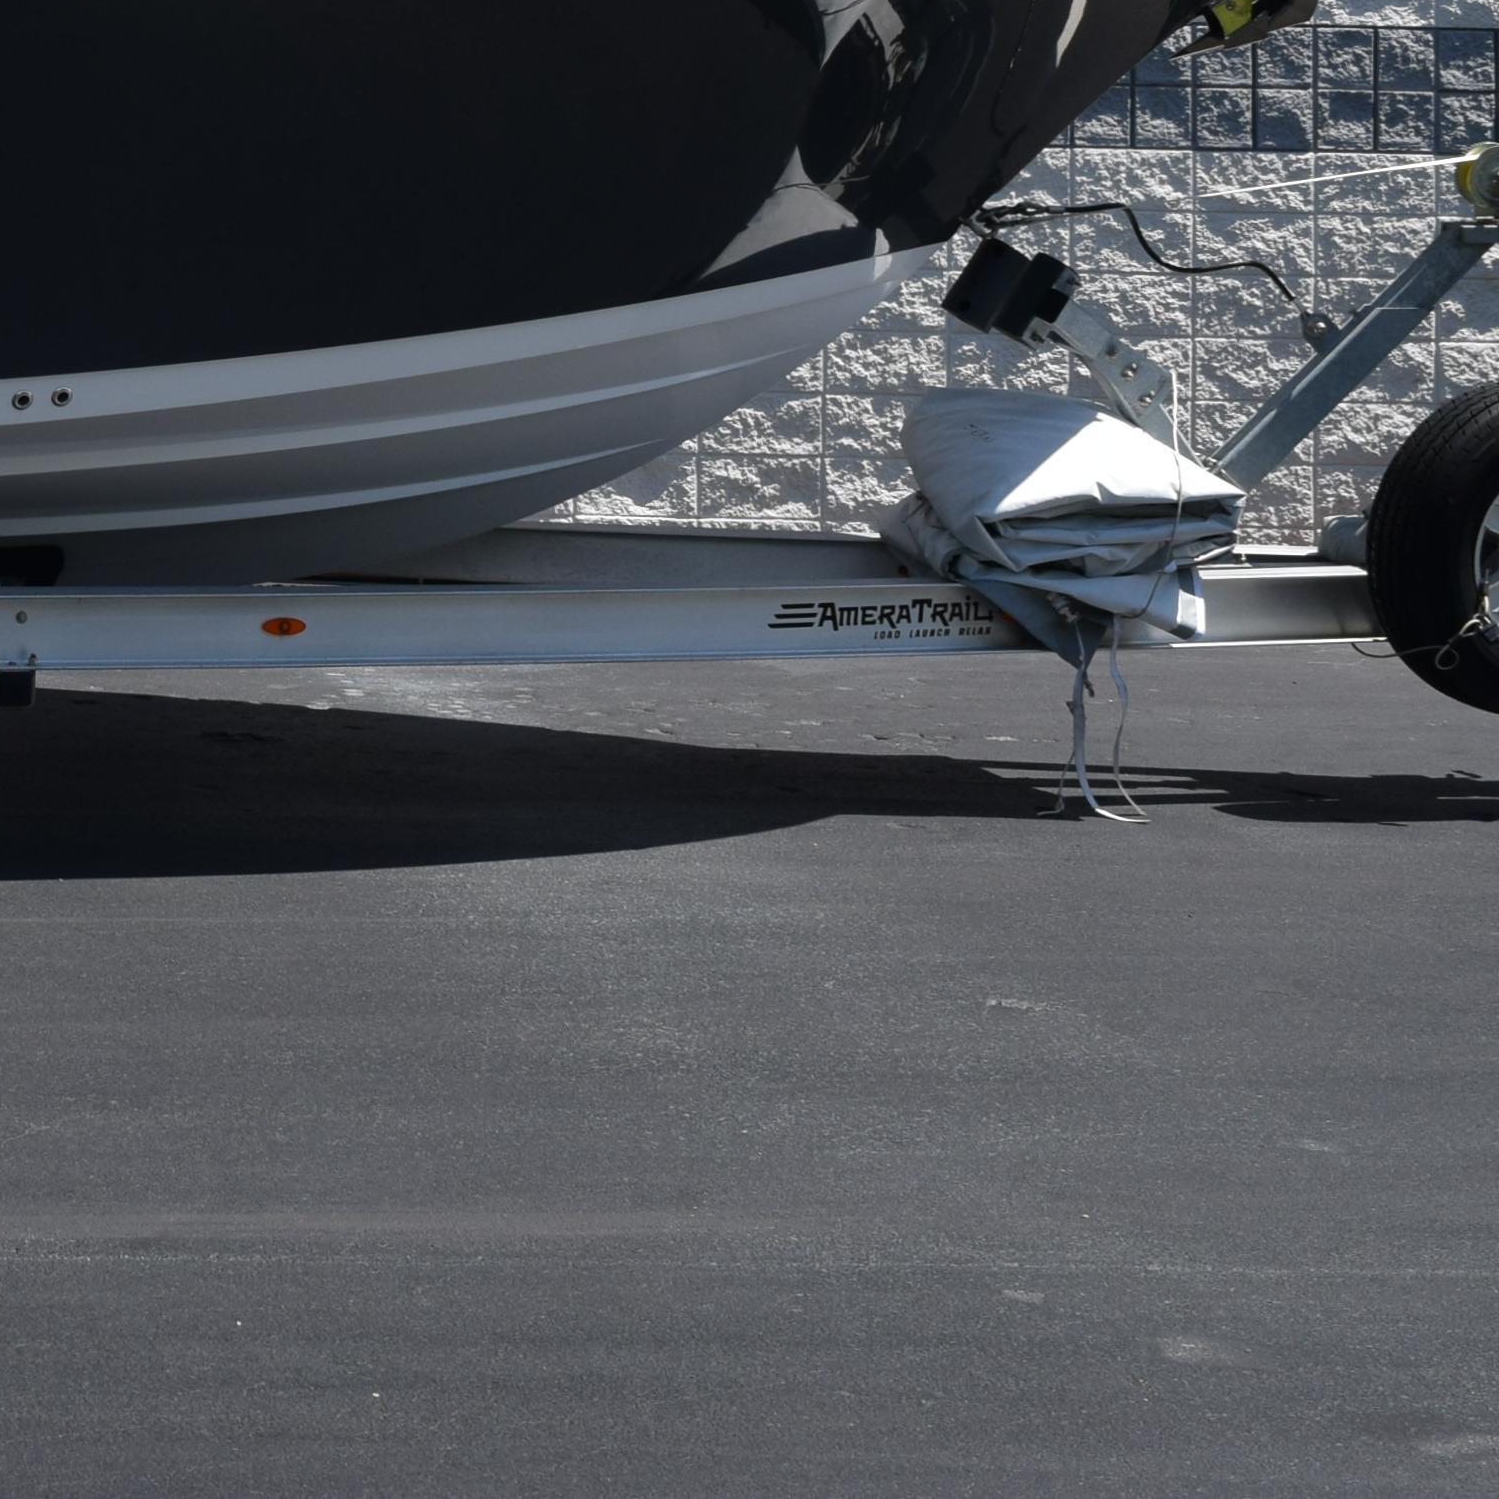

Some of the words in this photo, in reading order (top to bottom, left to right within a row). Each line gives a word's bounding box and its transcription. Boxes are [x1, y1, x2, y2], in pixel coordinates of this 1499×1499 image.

[874, 631, 902, 640] LOAD
[909, 628, 952, 639] LAUNCH
[958, 626, 993, 637] RELAX
